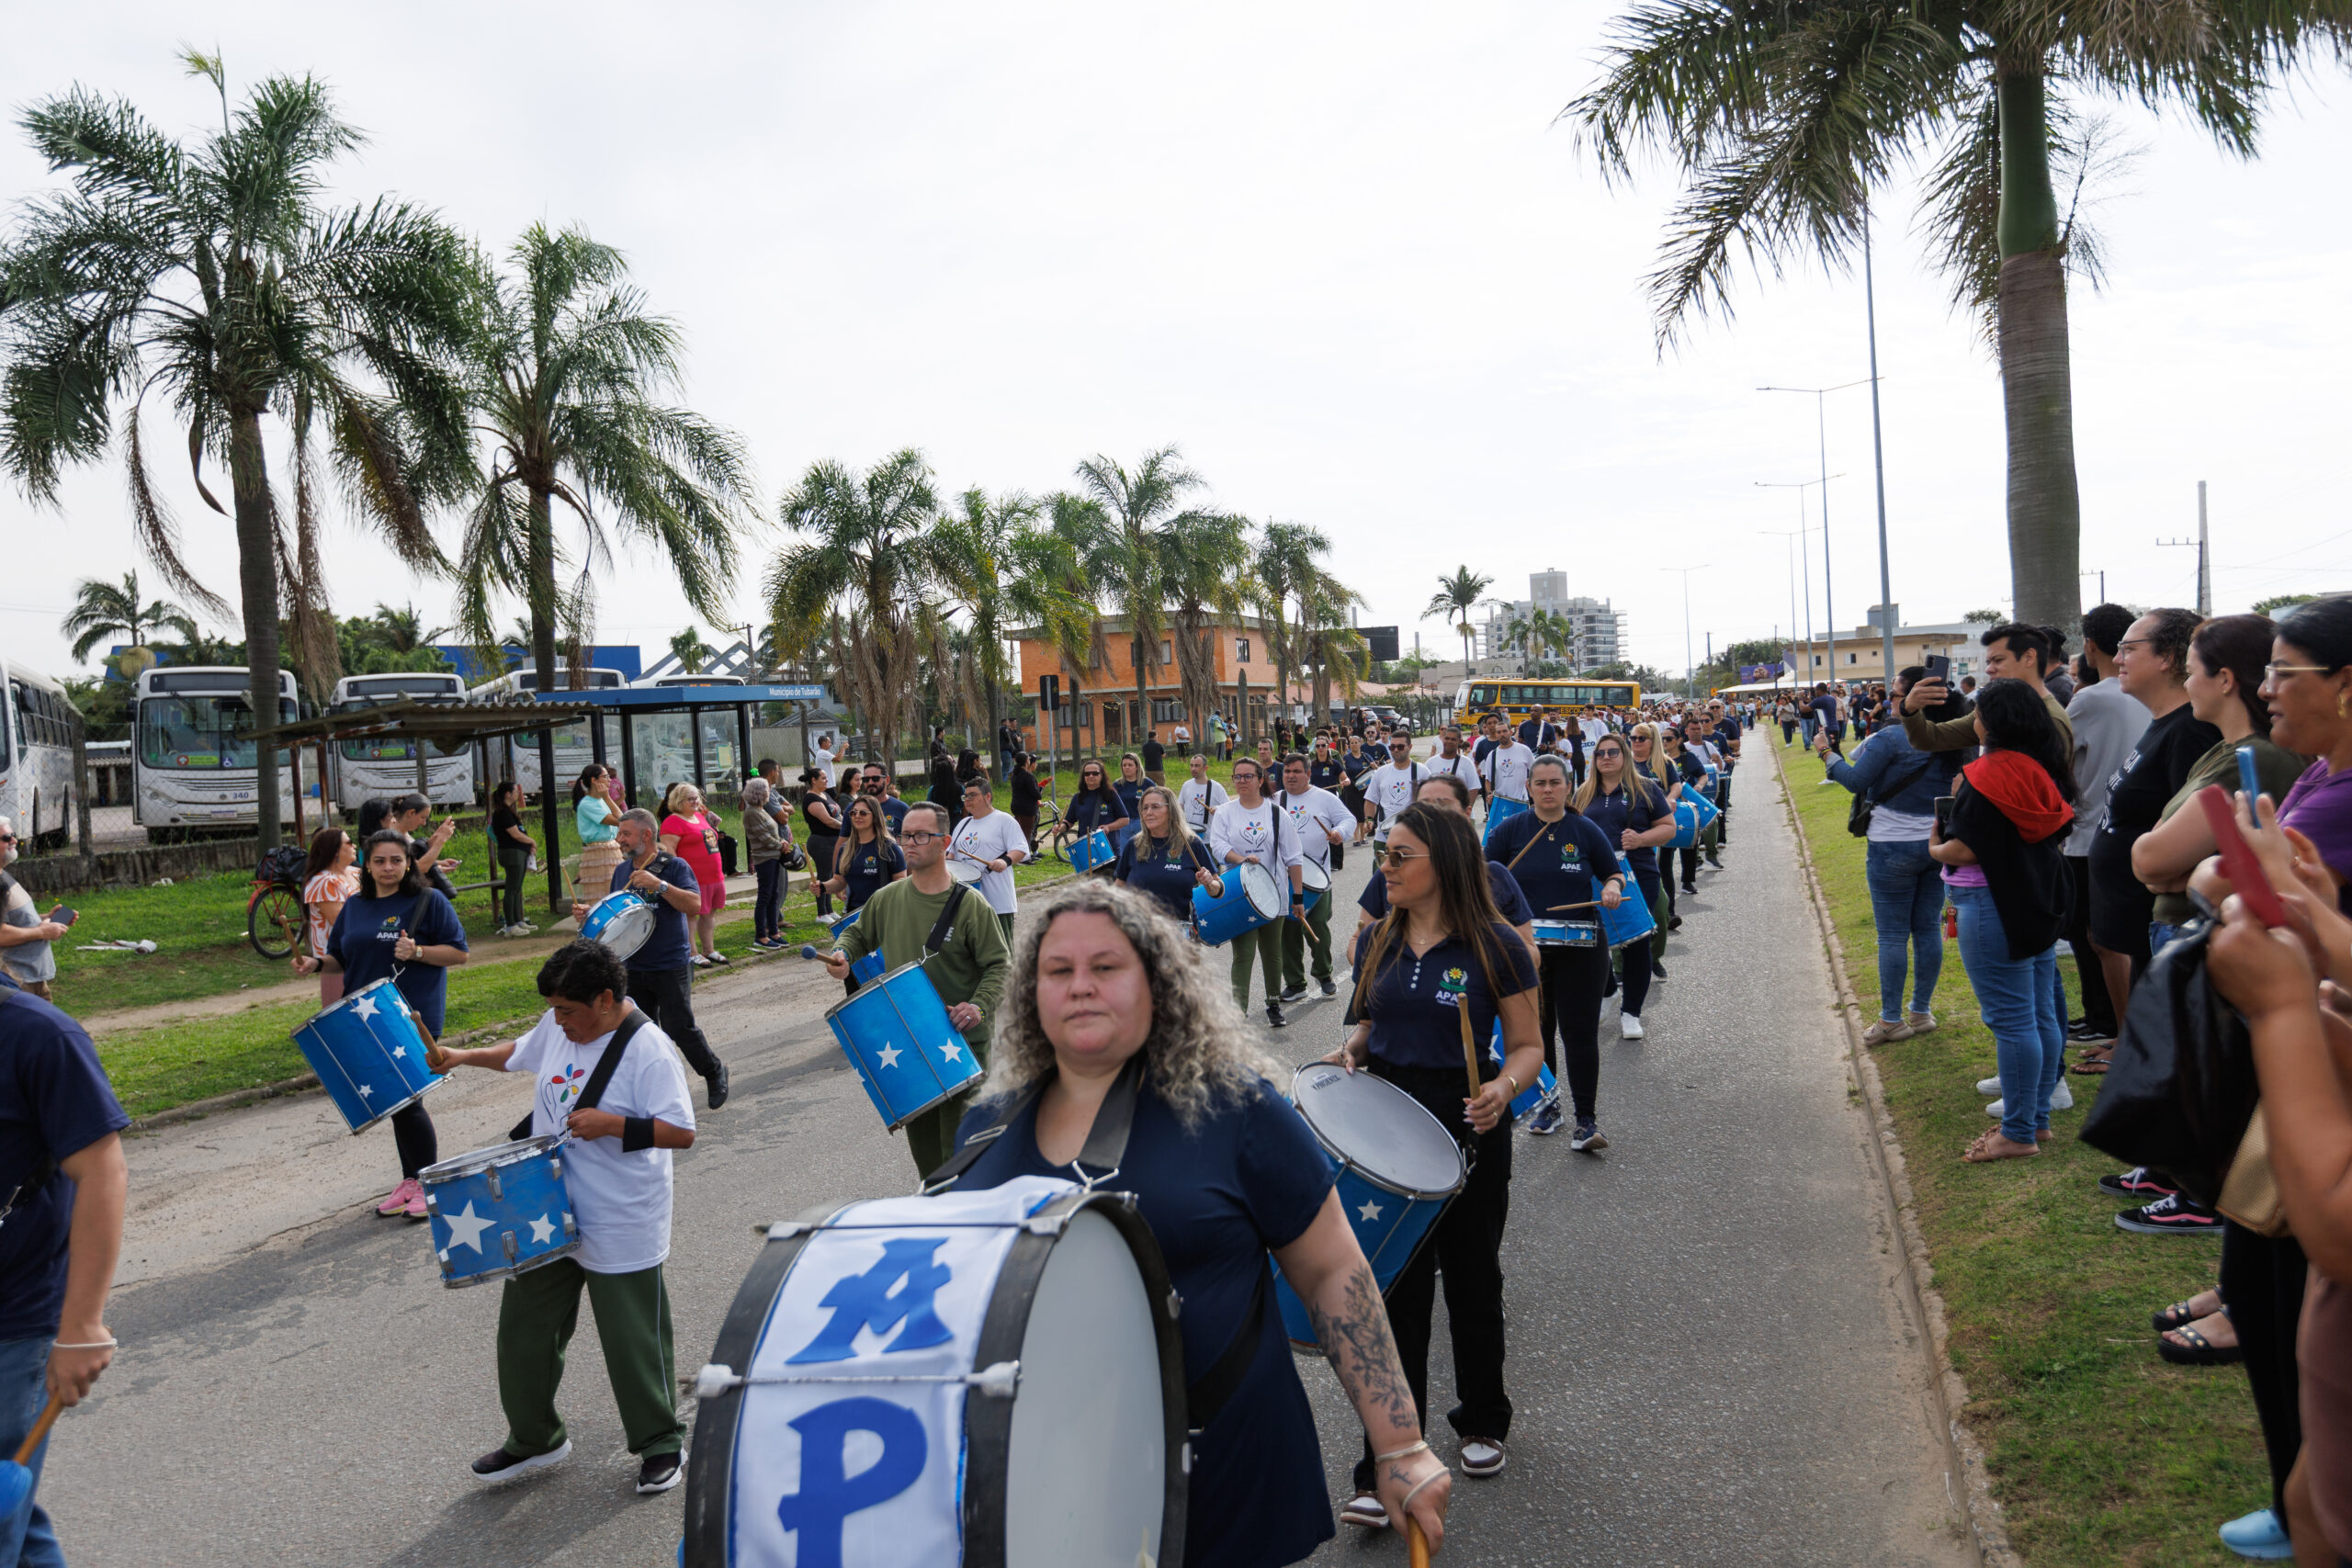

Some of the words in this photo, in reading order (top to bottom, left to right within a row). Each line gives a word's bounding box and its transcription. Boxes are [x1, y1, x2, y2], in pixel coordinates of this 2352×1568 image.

[794, 687, 801, 696] de
[801, 686, 821, 696] Tubarão
[1560, 863, 1581, 871] APAE
[1435, 989, 1459, 1002] APA
[785, 1236, 954, 1366] A
[777, 1394, 928, 1568] P
